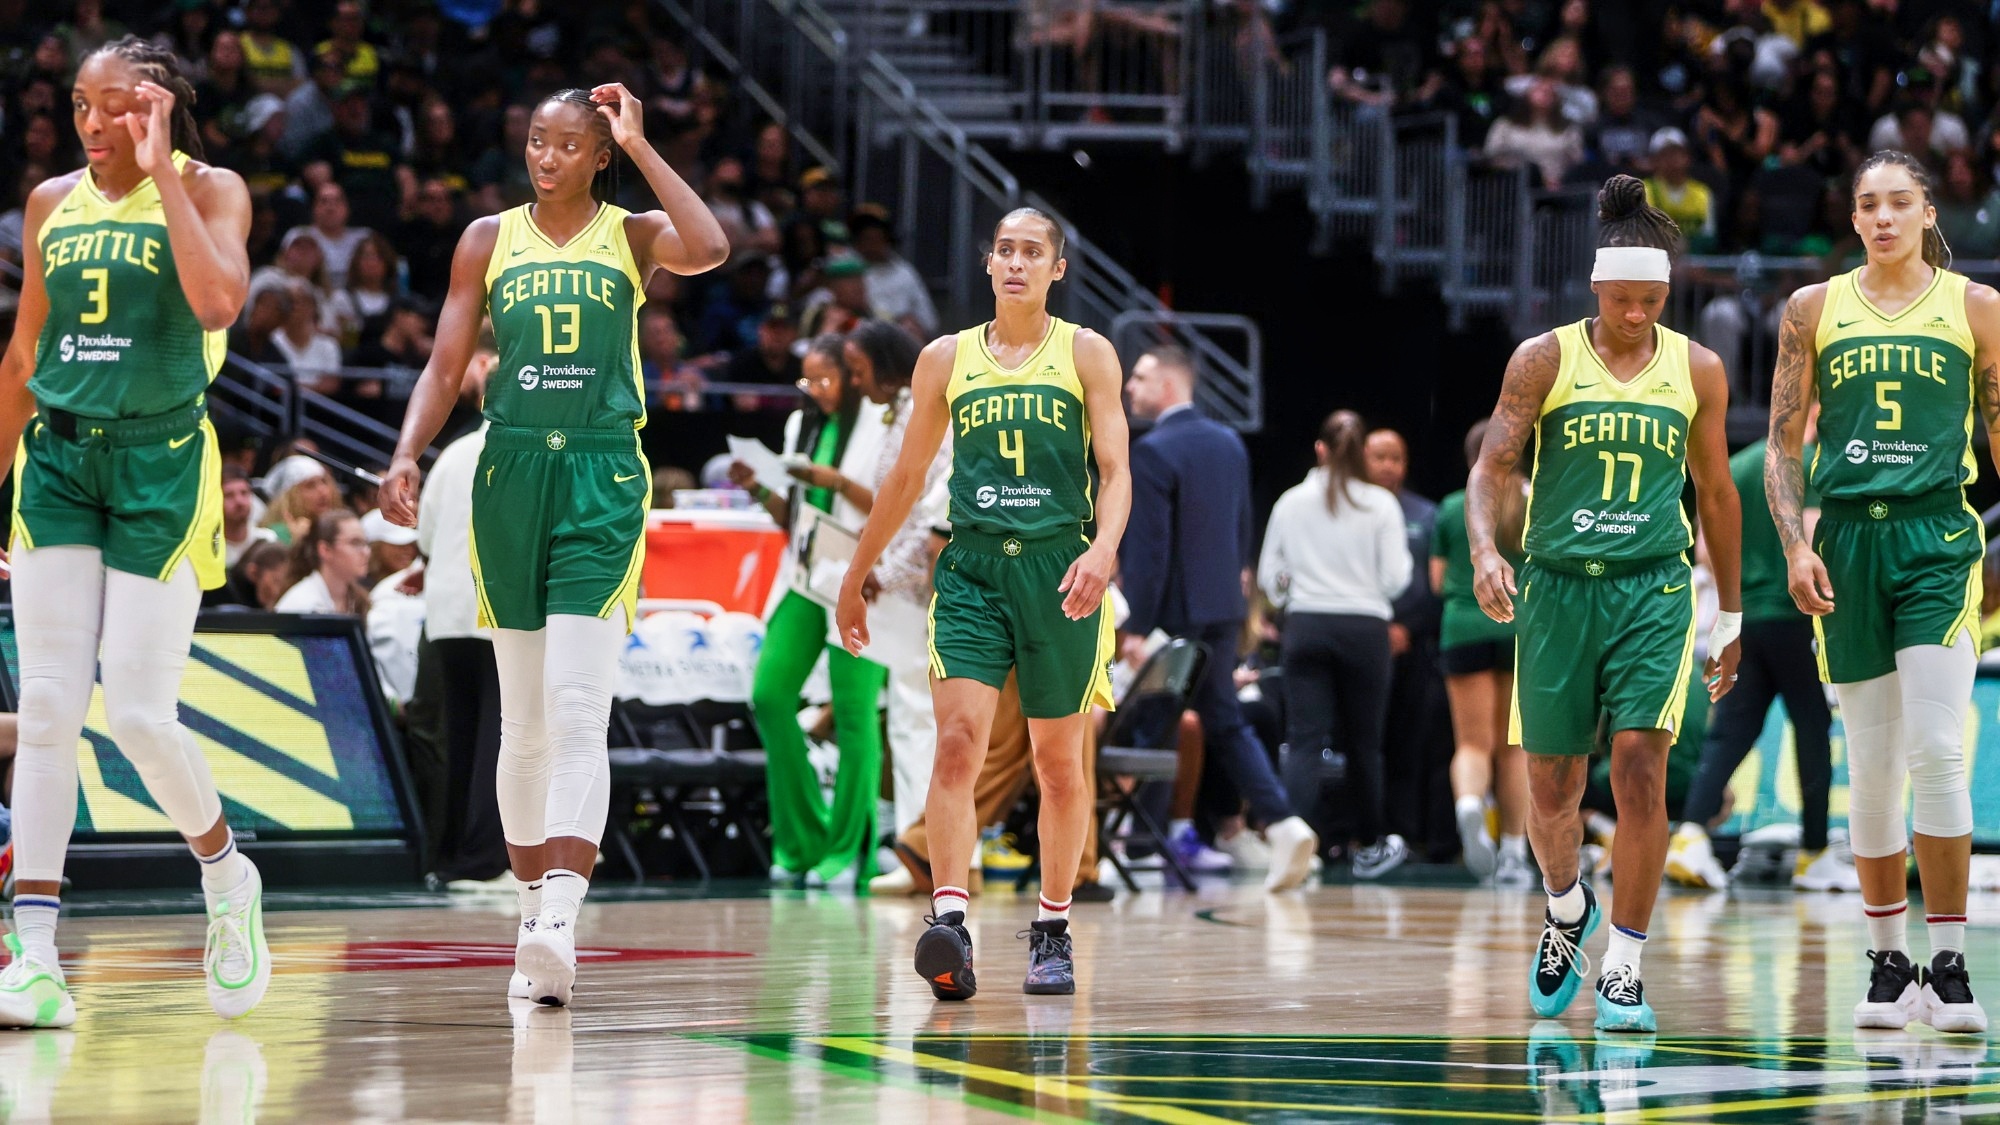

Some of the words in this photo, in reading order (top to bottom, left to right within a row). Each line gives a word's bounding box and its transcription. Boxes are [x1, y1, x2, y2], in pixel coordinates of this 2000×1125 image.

[44, 229, 162, 278] SEATTLE
[80, 268, 108, 324] 3
[502, 268, 616, 314] SEATTLE
[534, 303, 580, 354] 13
[77, 350, 120, 362] SWEDISH
[542, 364, 596, 376] Providence
[1829, 343, 1947, 389] SEATTLE
[542, 379, 583, 389] SWEDISH
[1875, 381, 1902, 431] 5
[958, 393, 1067, 438] SEATTLE
[1563, 412, 1680, 459] SEATTLE
[998, 429, 1025, 477] 4
[1871, 454, 1914, 465] SWEDISH
[1872, 440, 1929, 452] Providence
[1000, 484, 1052, 496] Providence
[1598, 450, 1643, 503] 17
[999, 498, 1040, 508] SWEDISH
[1598, 510, 1651, 522] Providence
[1594, 523, 1636, 535] SWEDISH
